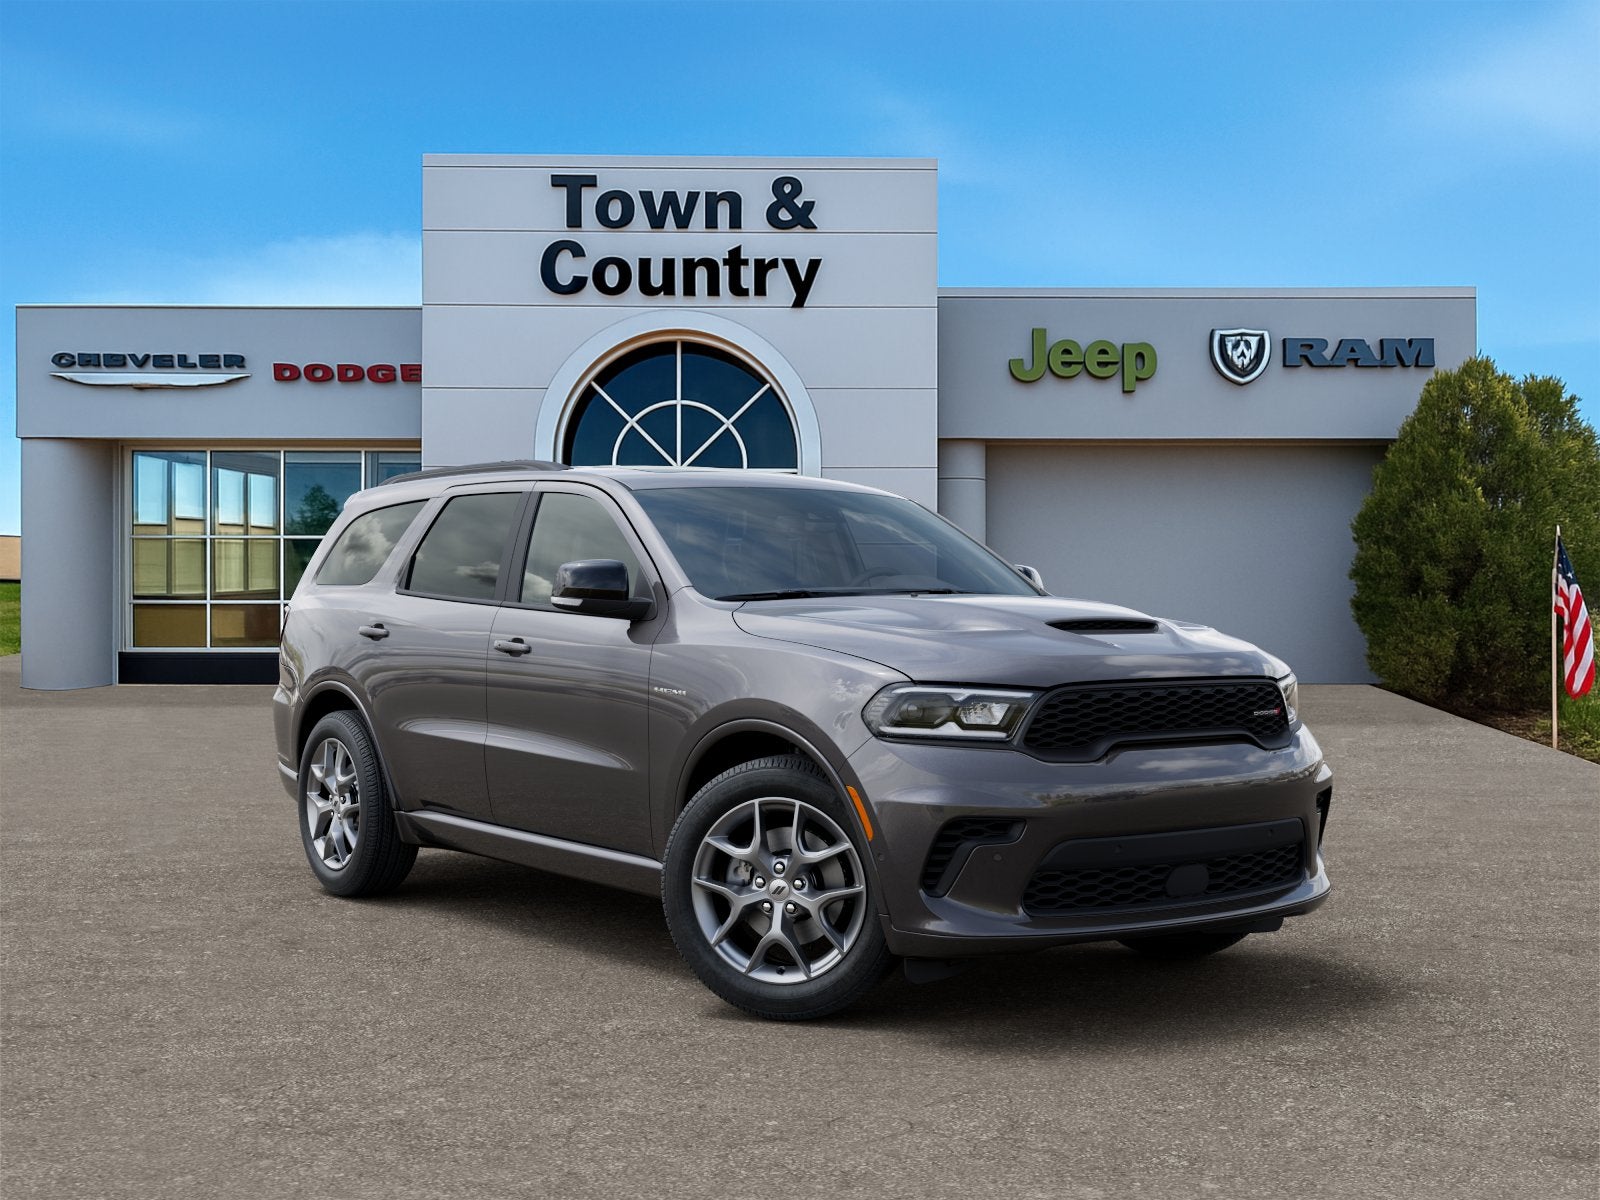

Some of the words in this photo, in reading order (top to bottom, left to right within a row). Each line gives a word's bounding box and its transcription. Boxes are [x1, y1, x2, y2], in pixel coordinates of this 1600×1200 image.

[550, 174, 743, 230] Town
[765, 175, 818, 230] &
[539, 239, 823, 309] Country
[272, 362, 422, 383] DODGE
[1008, 327, 1158, 394] Jeep
[1282, 337, 1436, 368] RAM
